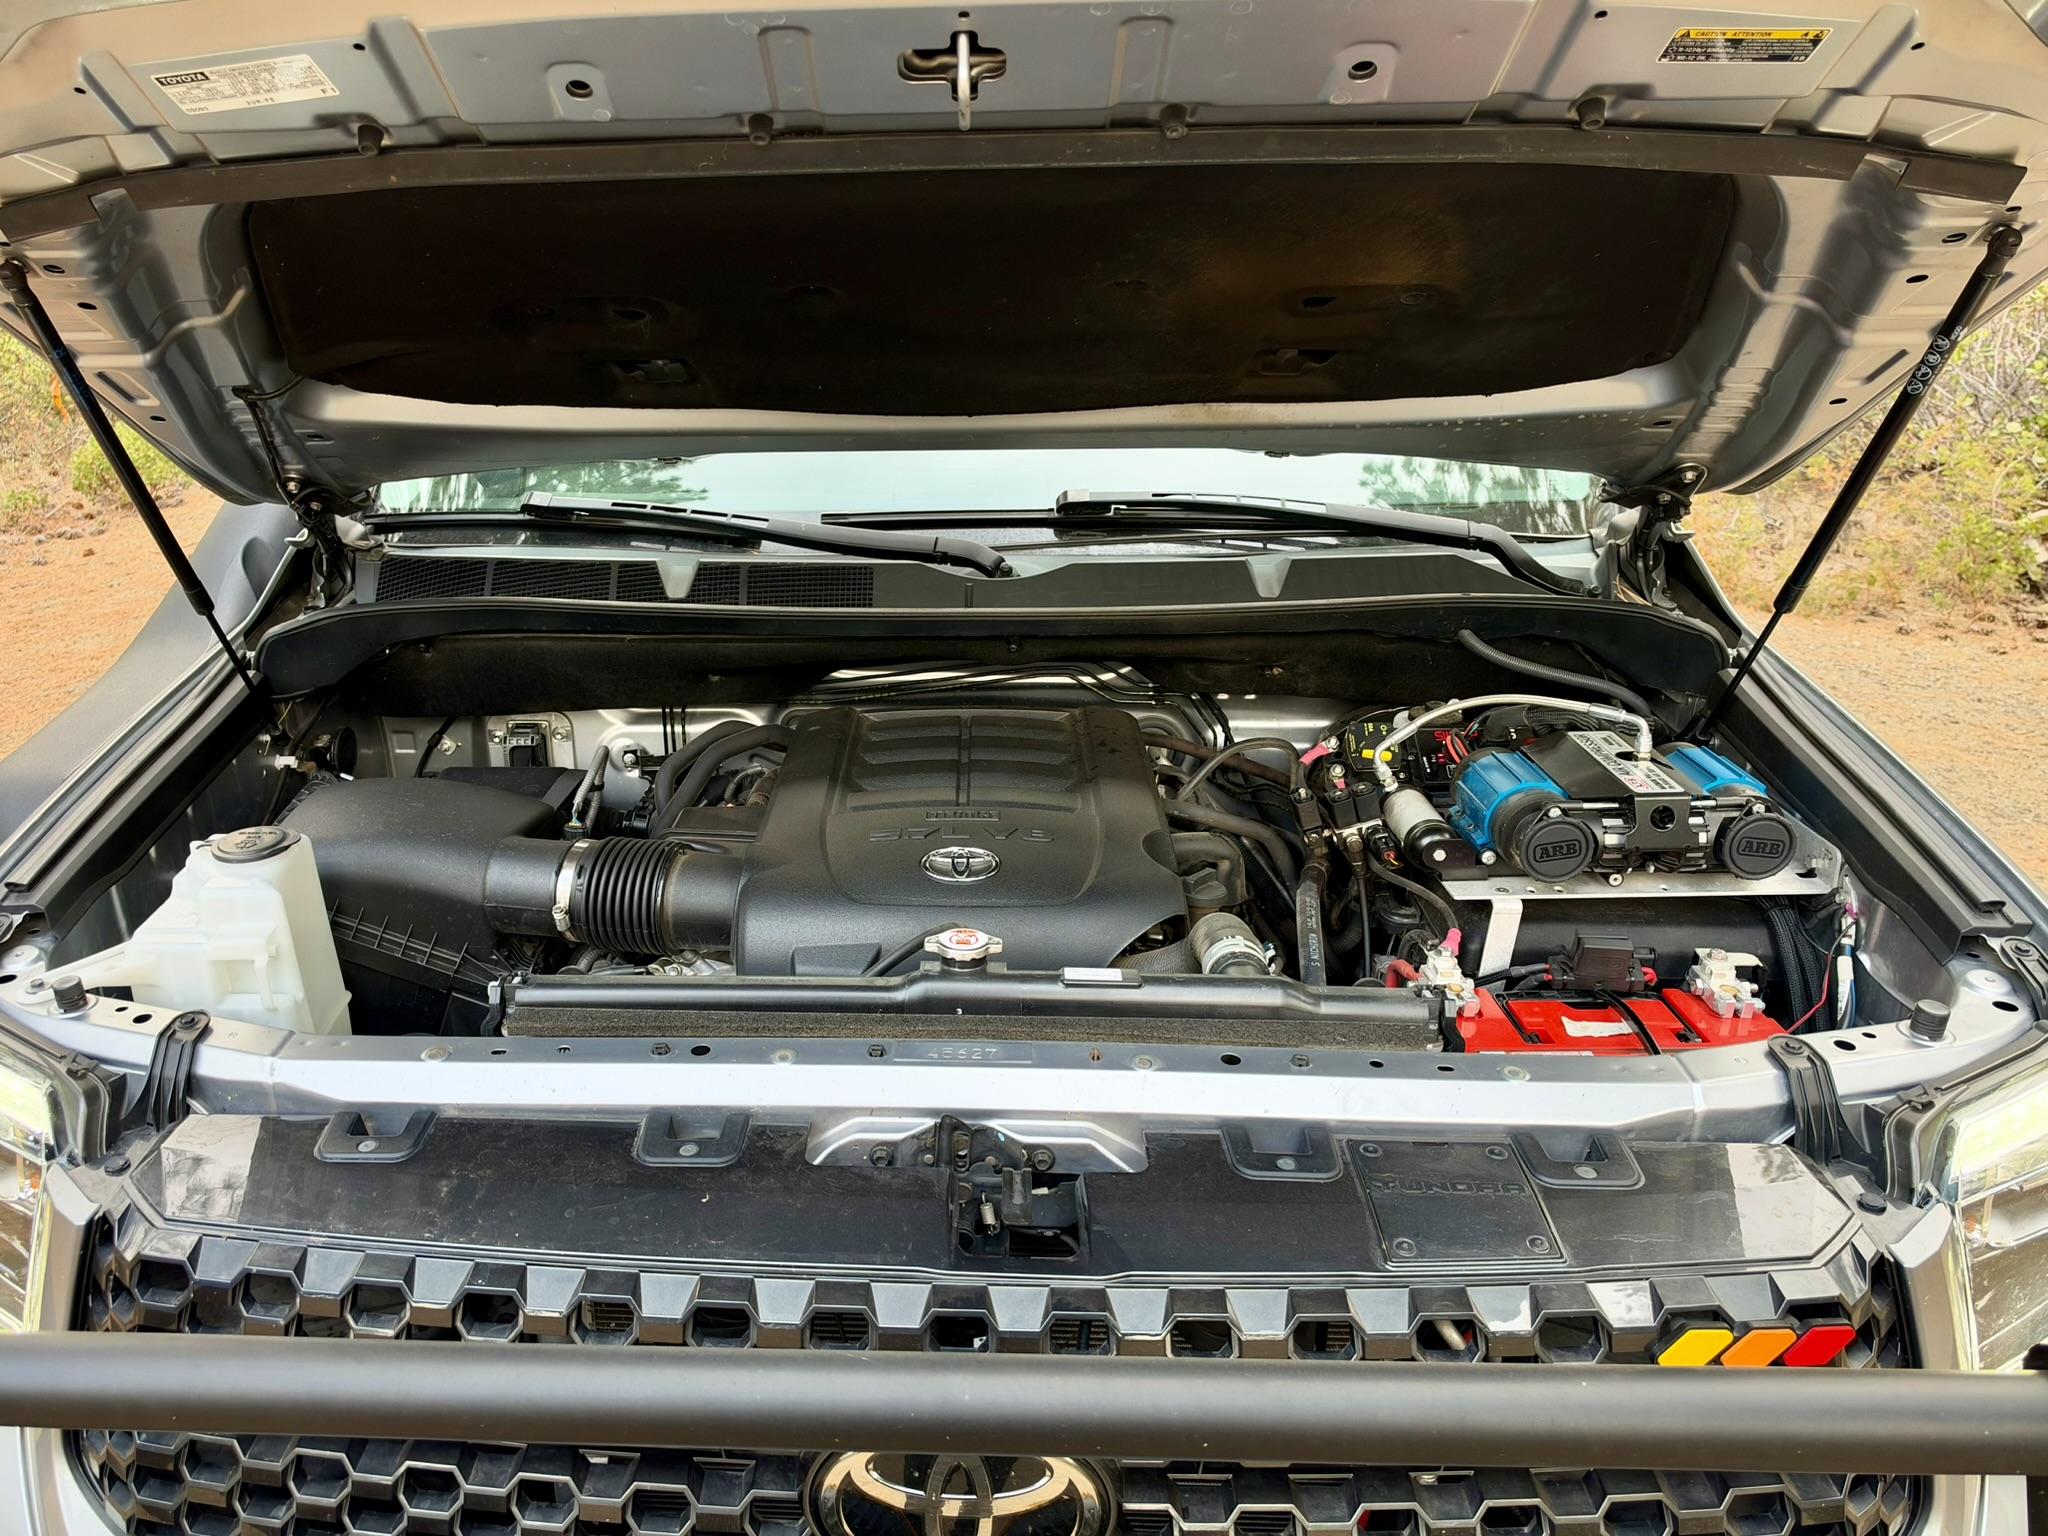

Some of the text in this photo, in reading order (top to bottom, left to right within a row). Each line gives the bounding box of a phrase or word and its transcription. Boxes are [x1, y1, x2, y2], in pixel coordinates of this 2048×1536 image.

[159, 72, 209, 86] TOYOTA
[1538, 843, 1578, 860] ARB
[1741, 840, 1781, 855] ARB
[1370, 1180, 1528, 1196] TUNDRA
